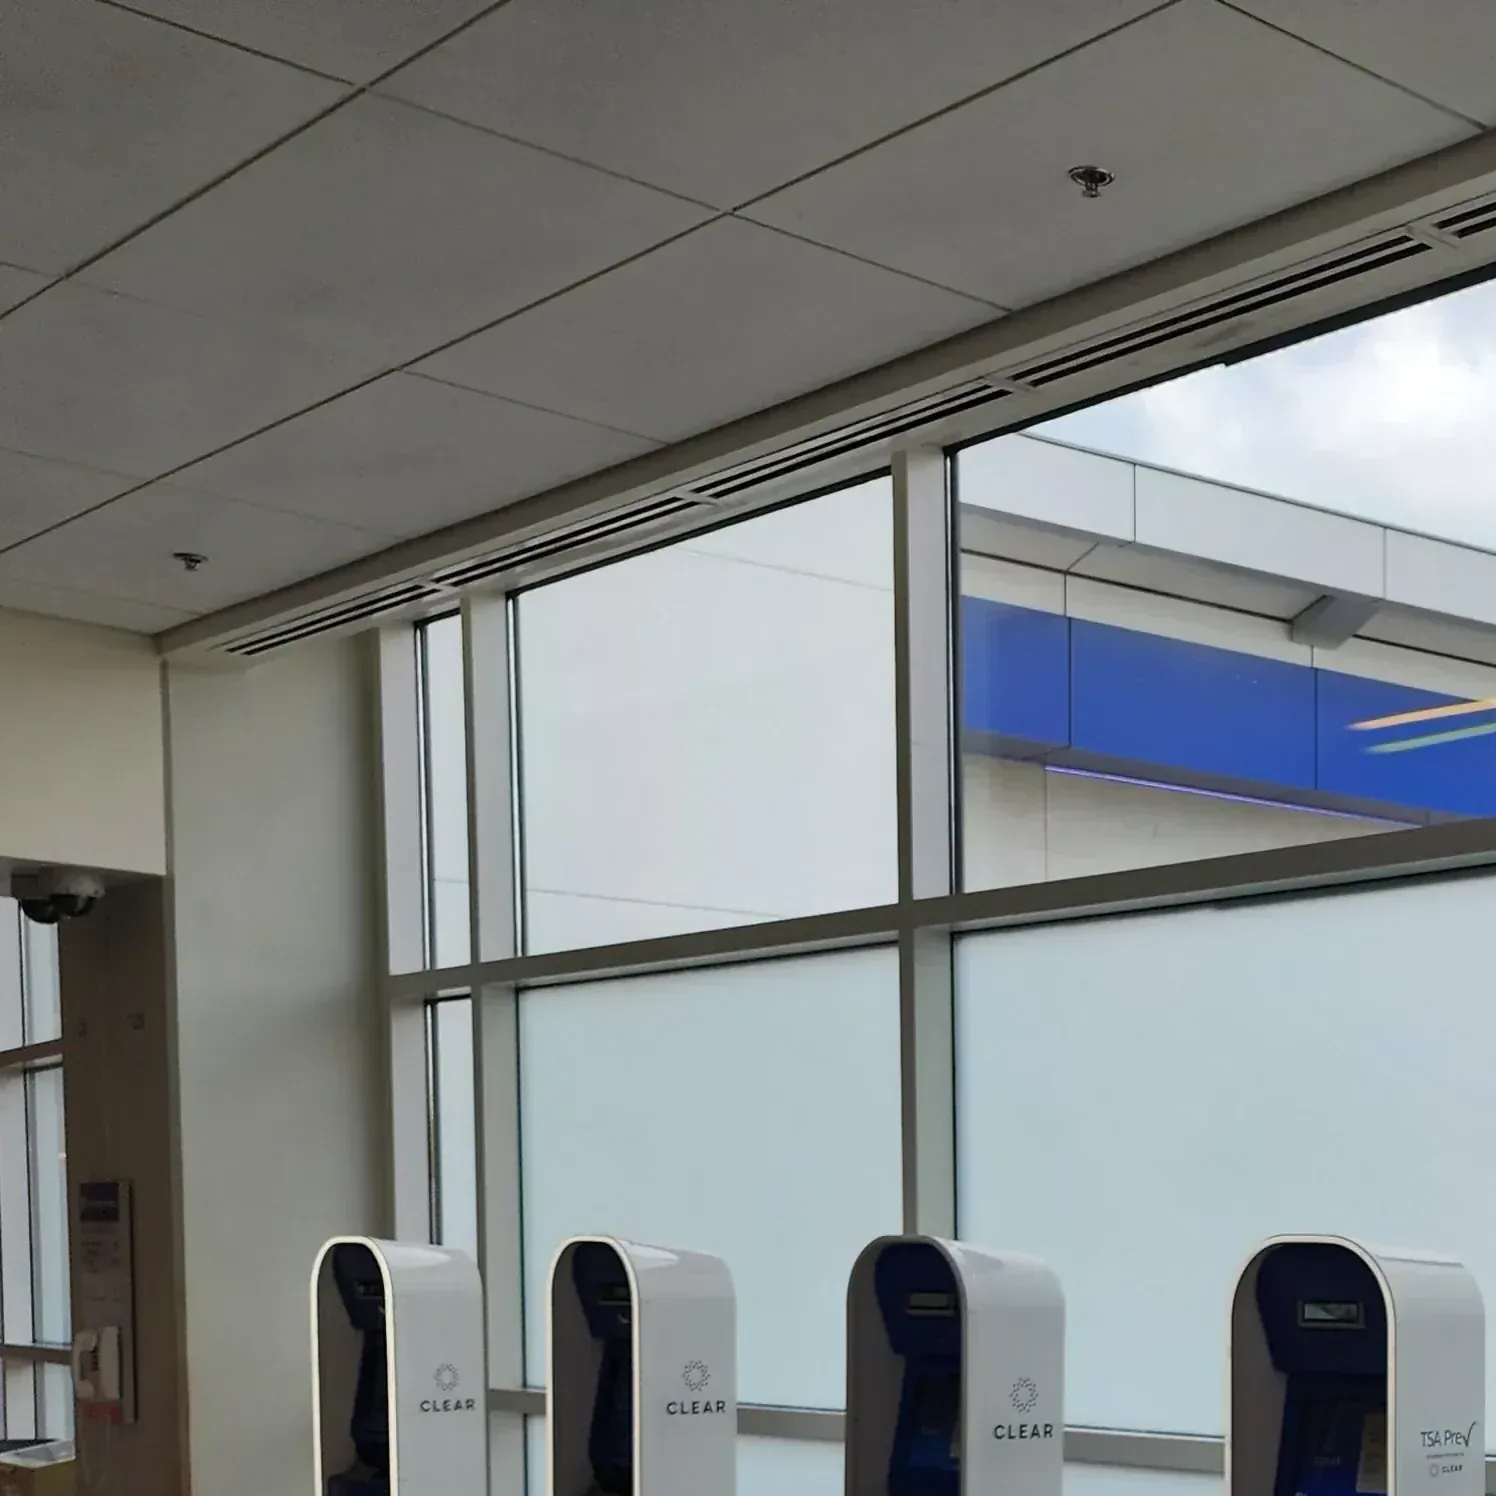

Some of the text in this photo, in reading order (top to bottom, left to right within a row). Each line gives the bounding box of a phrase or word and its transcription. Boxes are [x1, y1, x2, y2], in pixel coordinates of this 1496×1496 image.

[420, 1398, 476, 1412] CLEAR
[667, 1400, 725, 1415] CLEAR
[994, 1424, 1053, 1440] CLEAR
[1420, 1430, 1441, 1448] TSA
